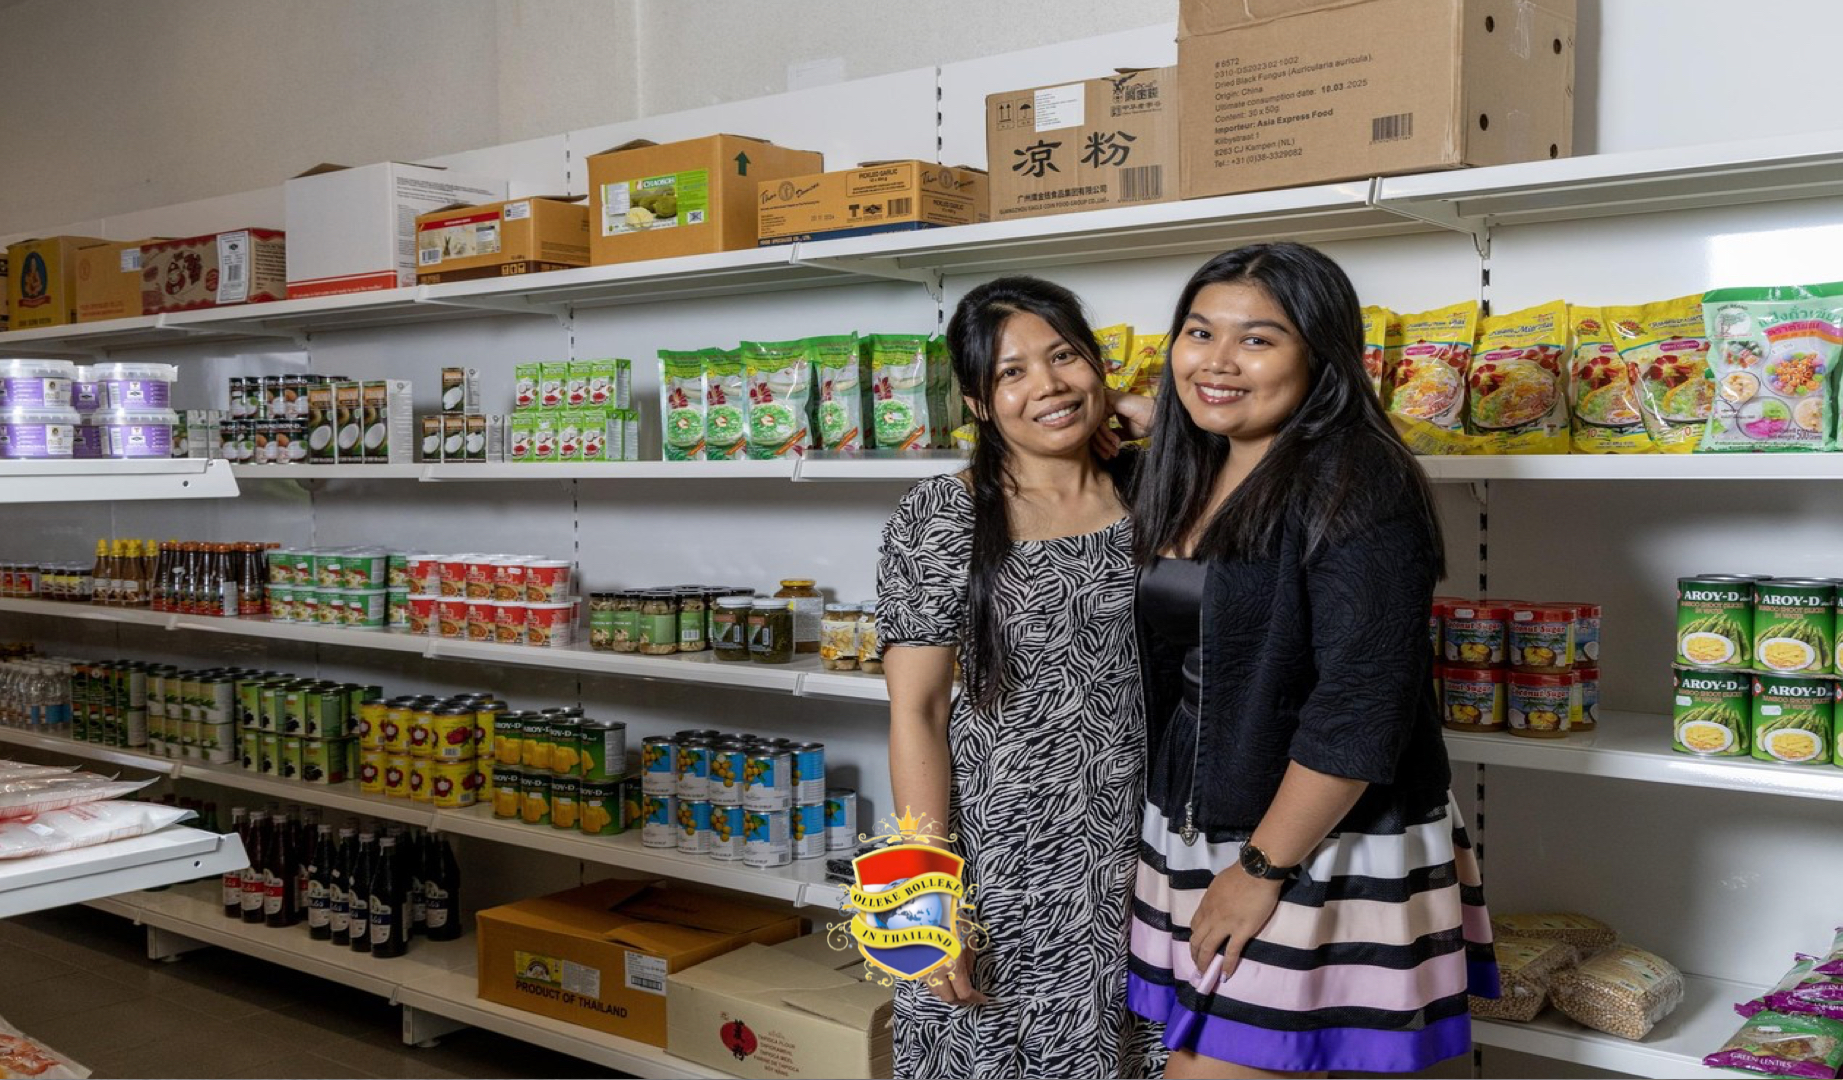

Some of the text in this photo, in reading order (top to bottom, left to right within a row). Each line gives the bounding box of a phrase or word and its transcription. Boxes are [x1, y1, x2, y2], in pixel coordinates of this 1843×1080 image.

[1215, 79, 1235, 90] Dried
[1236, 75, 1256, 86] Black
[1257, 71, 1286, 82] Fungus
[1241, 86, 1263, 97] China
[1215, 100, 1246, 112] Ultimate
[1247, 92, 1295, 107] consumption
[1296, 89, 1316, 99] date:
[1215, 112, 1246, 123] Content:
[1247, 109, 1258, 118] 30
[1265, 104, 1280, 115] 50g
[1215, 108, 1334, 135] Importeur: Asia Express Food
[1234, 145, 1244, 155] CJ
[1245, 141, 1276, 153] Kampen
[1277, 138, 1296, 149] (NL)
[1684, 590, 1740, 602] AROY-D
[1762, 594, 1820, 607] AROY-D
[1682, 678, 1738, 690] AROY-D
[1768, 685, 1826, 697] AROY-D
[515, 980, 628, 1019] PRODUCT OF THAILAND
[1730, 1052, 1758, 1063] GREEN
